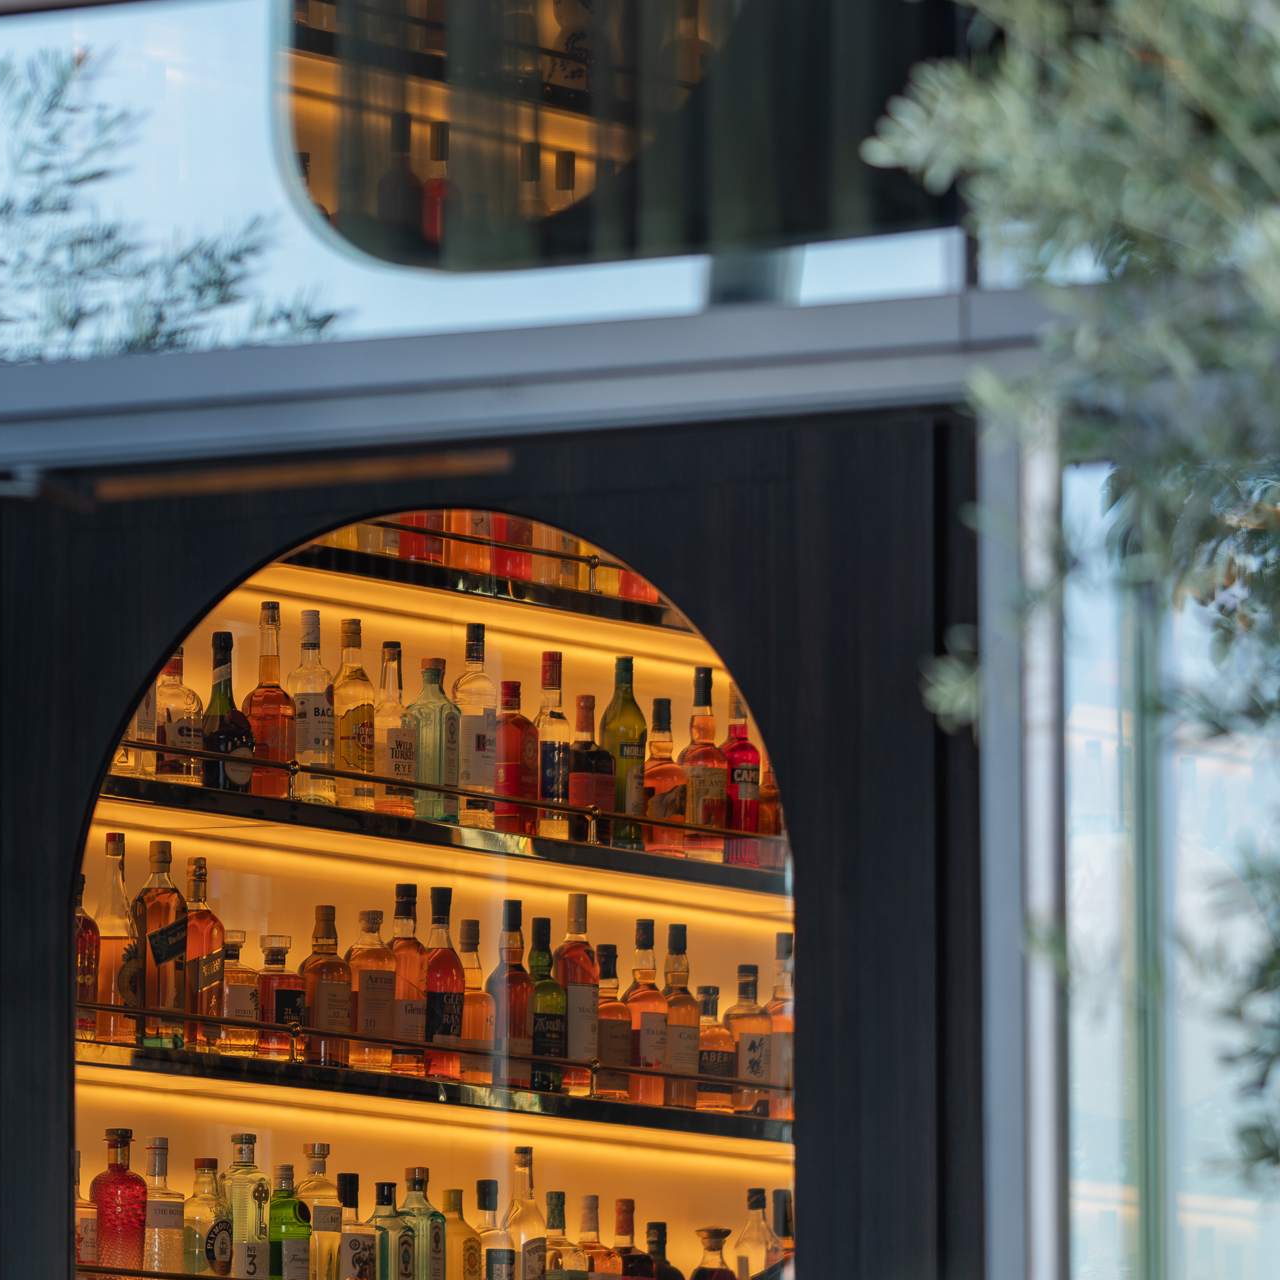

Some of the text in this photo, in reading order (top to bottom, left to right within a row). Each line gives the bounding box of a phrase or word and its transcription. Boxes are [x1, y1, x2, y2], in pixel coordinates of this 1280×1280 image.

[395, 740, 412, 751] WILD
[394, 764, 412, 772] RYE
[366, 975, 393, 985] Arran
[365, 1019, 376, 1028] 10
[154, 1208, 167, 1216] THE
[247, 1254, 257, 1275] 3
